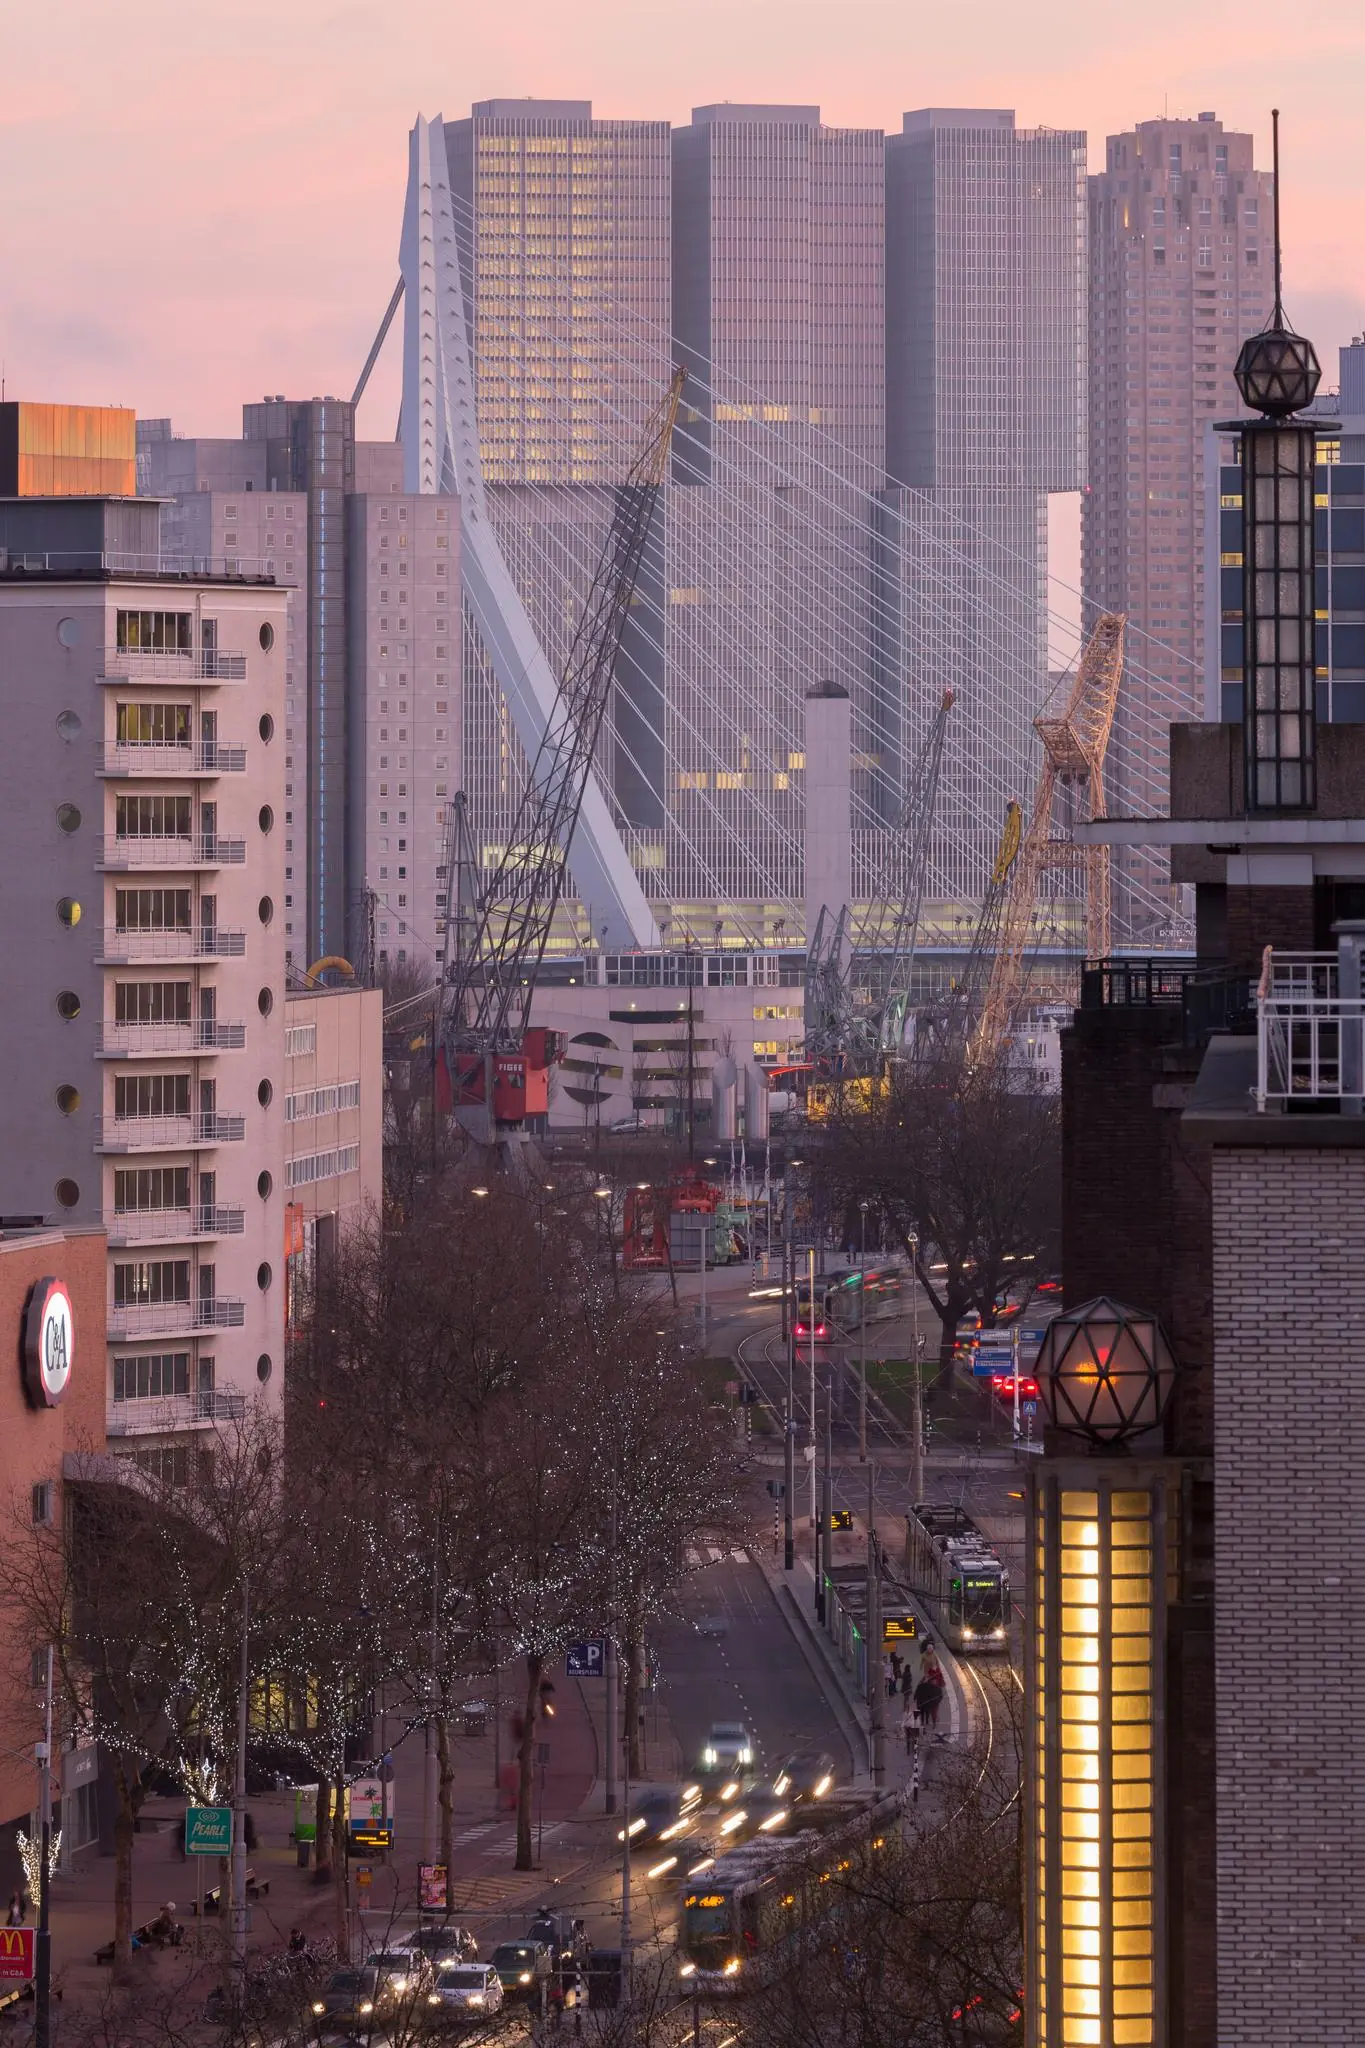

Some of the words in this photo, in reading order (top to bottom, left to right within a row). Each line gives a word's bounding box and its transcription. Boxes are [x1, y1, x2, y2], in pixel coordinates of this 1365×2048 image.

[45, 1313, 68, 1372] C&A
[587, 1645, 600, 1666] P
[192, 1822, 227, 1836] PEARLE
